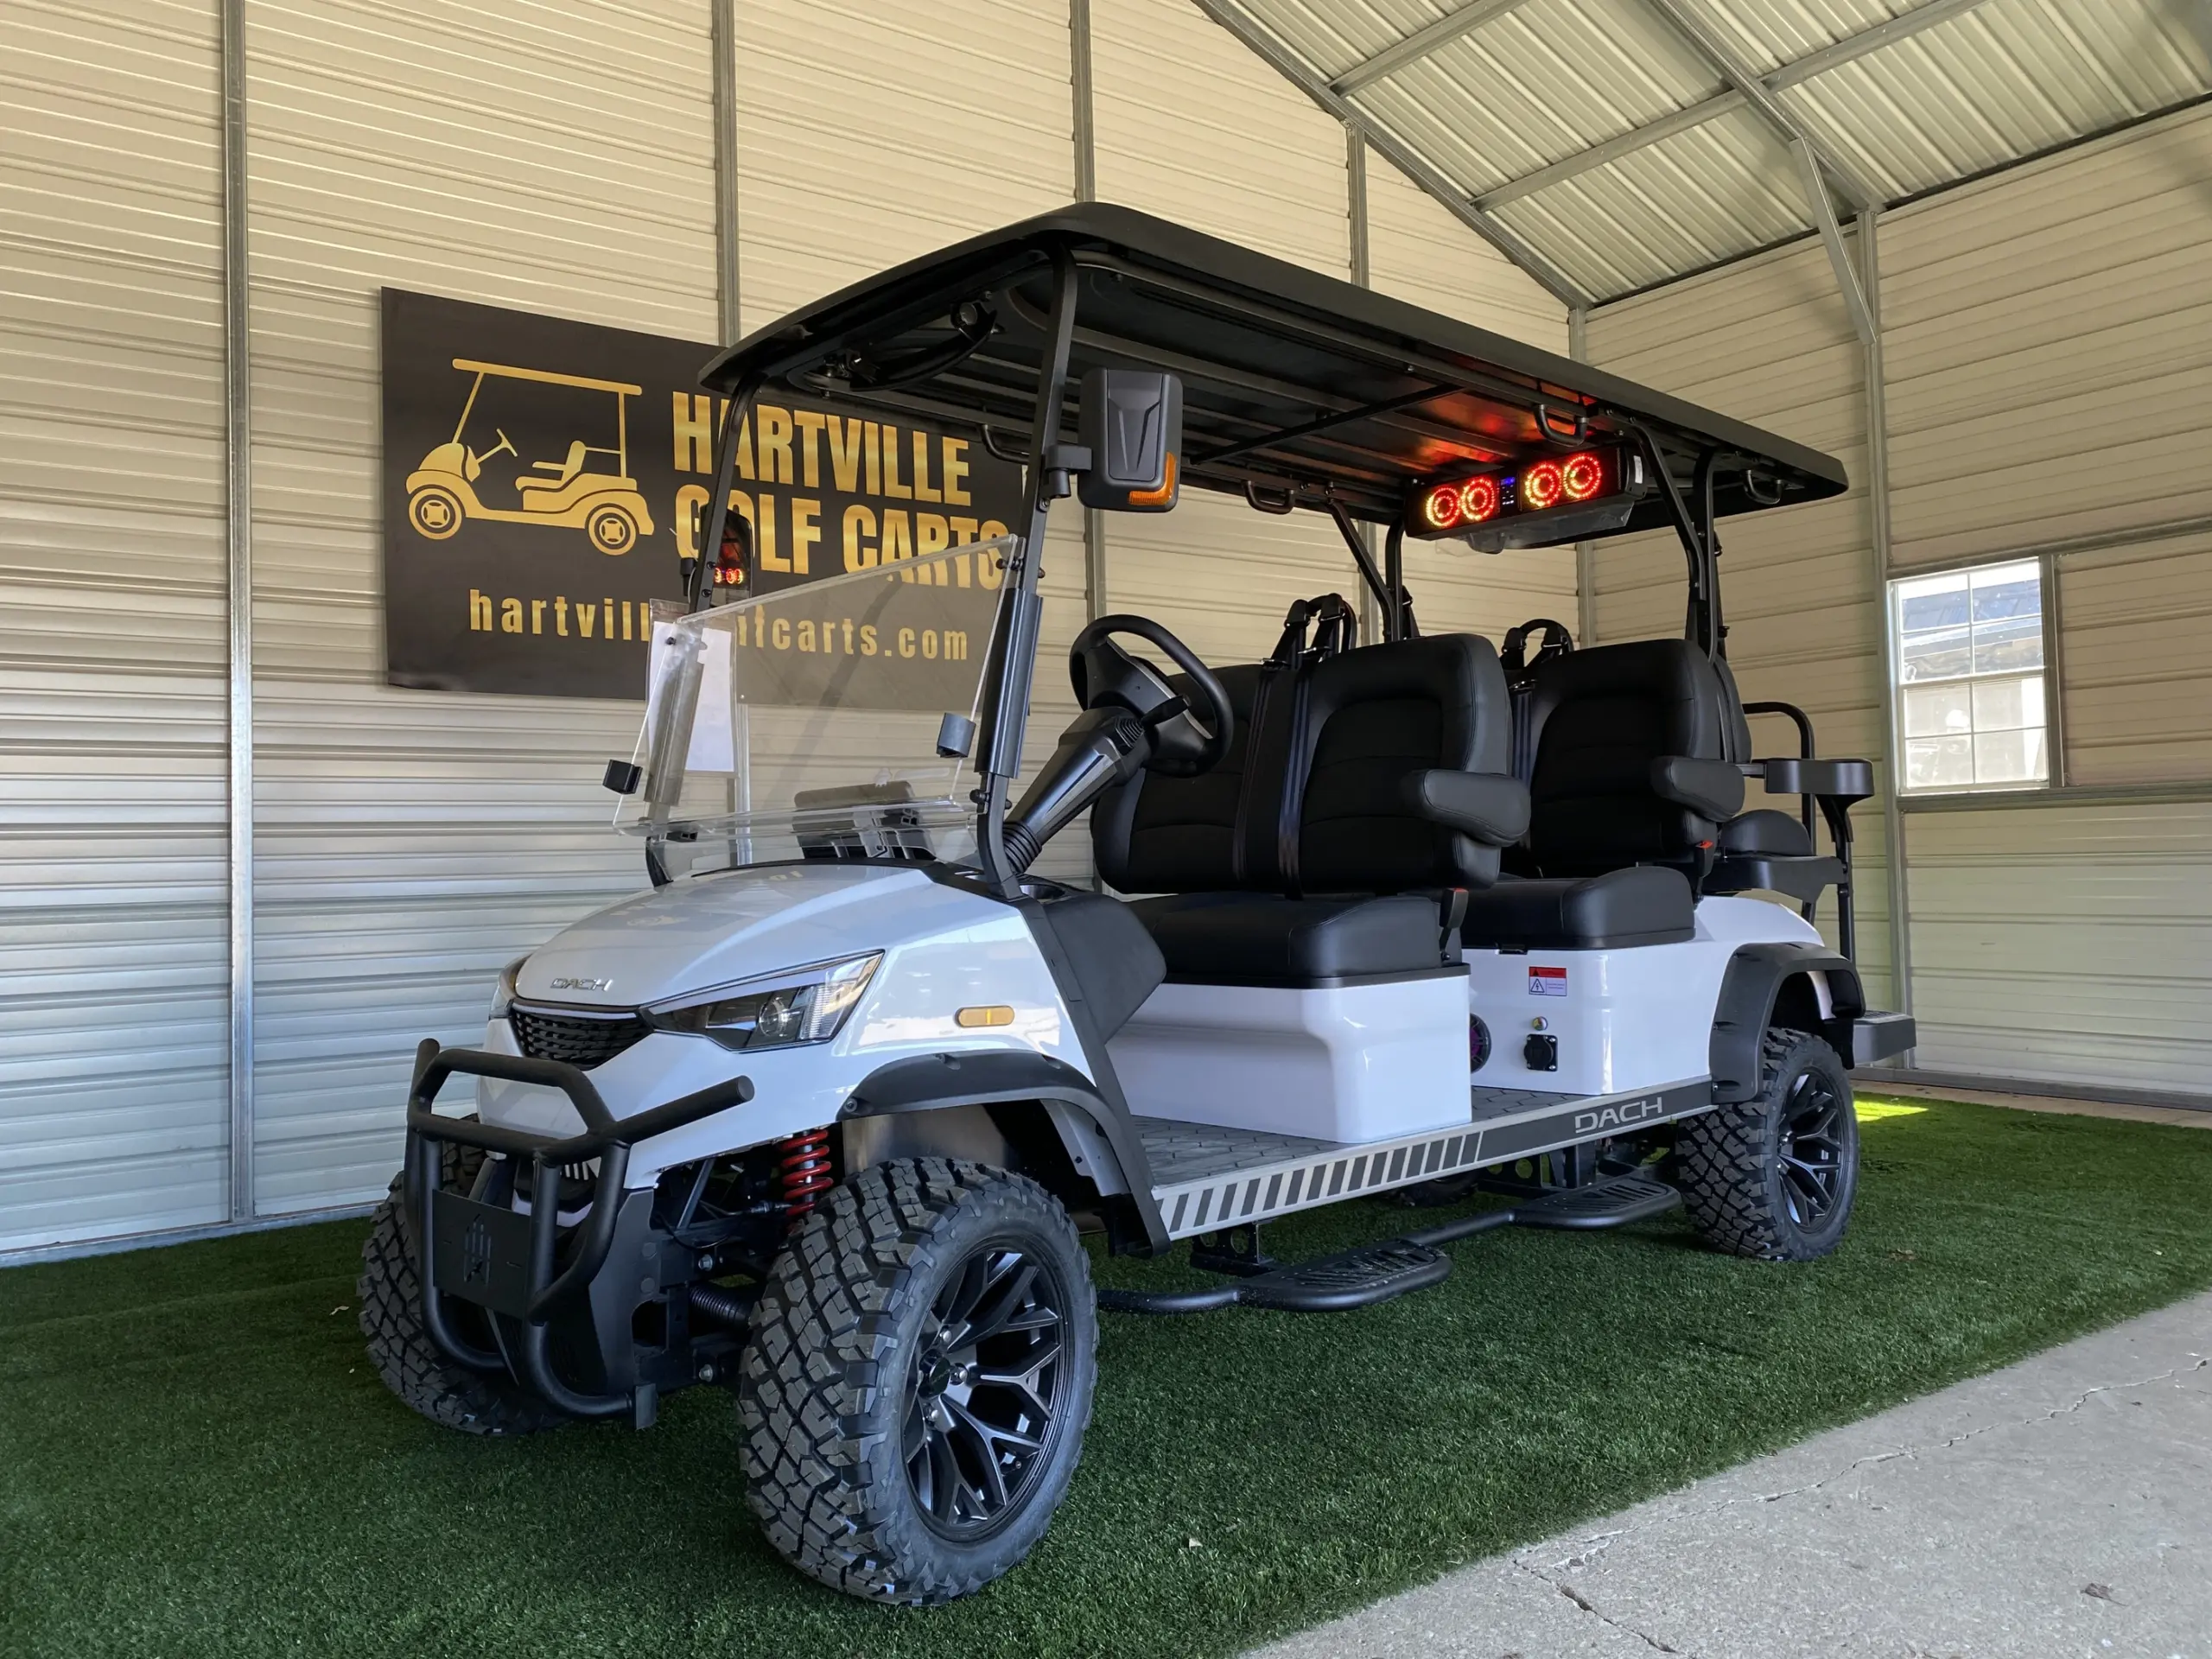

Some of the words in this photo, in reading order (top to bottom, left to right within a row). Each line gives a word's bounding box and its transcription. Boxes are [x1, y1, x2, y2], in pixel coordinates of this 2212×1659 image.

[842, 504, 1009, 590] CARTS
[469, 588, 968, 660] hartvilllfcarts.com
[550, 977, 613, 992] DACH
[1574, 1096, 1663, 1134] DACH
